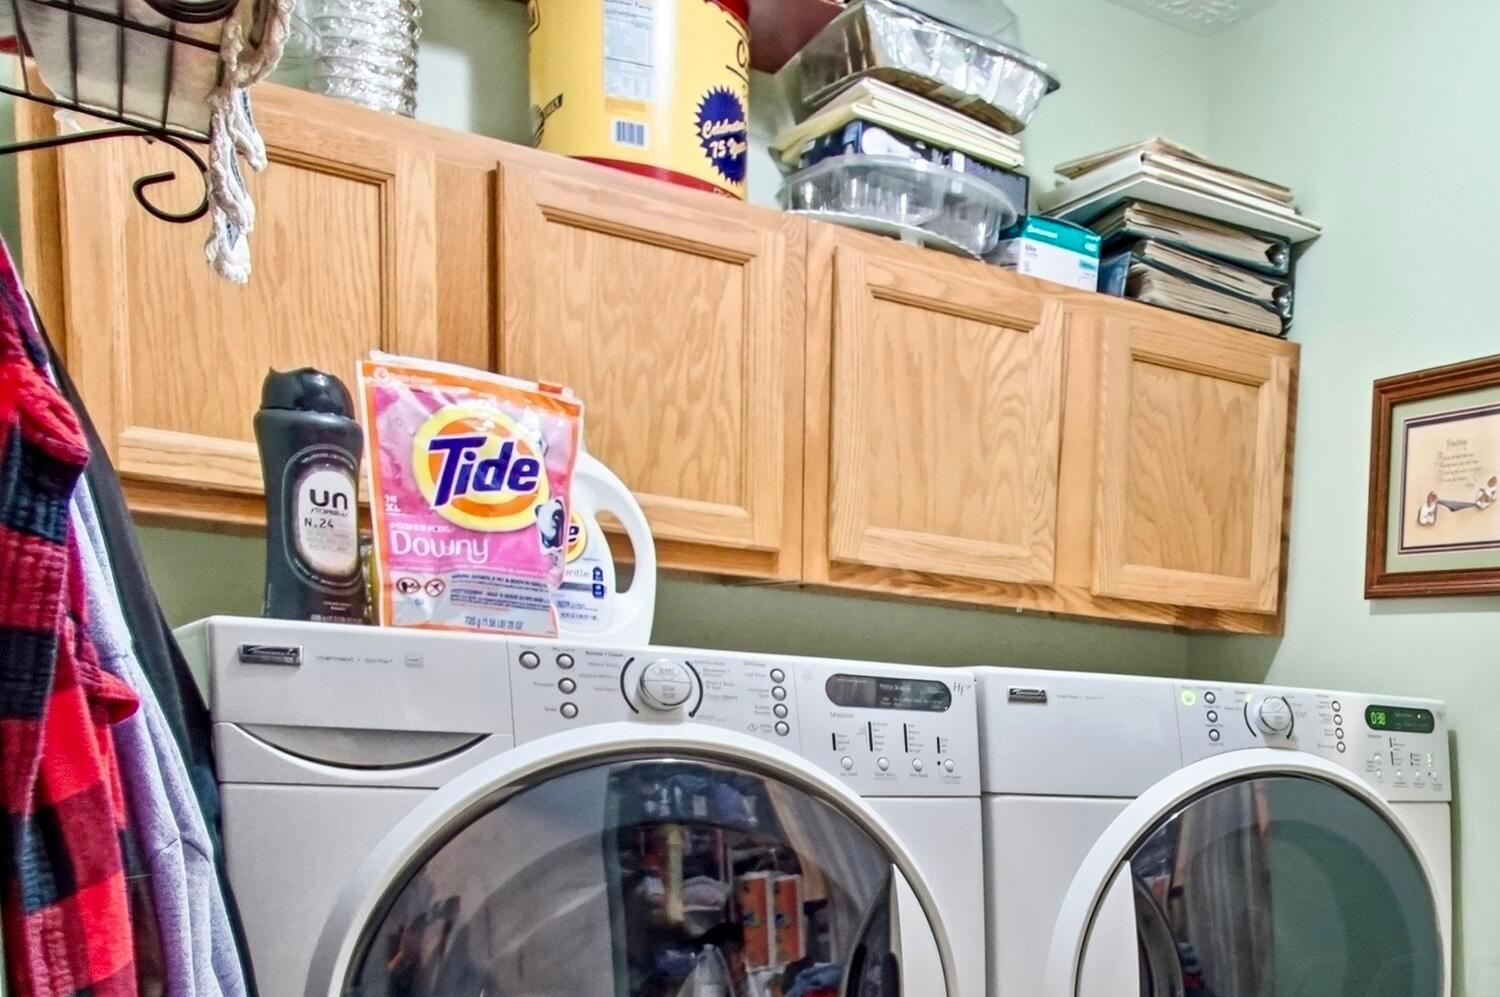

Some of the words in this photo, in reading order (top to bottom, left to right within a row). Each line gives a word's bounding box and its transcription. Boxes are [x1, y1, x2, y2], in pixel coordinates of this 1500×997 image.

[427, 436, 541, 507] Tide
[309, 488, 349, 511] un
[390, 530, 490, 564] Downy
